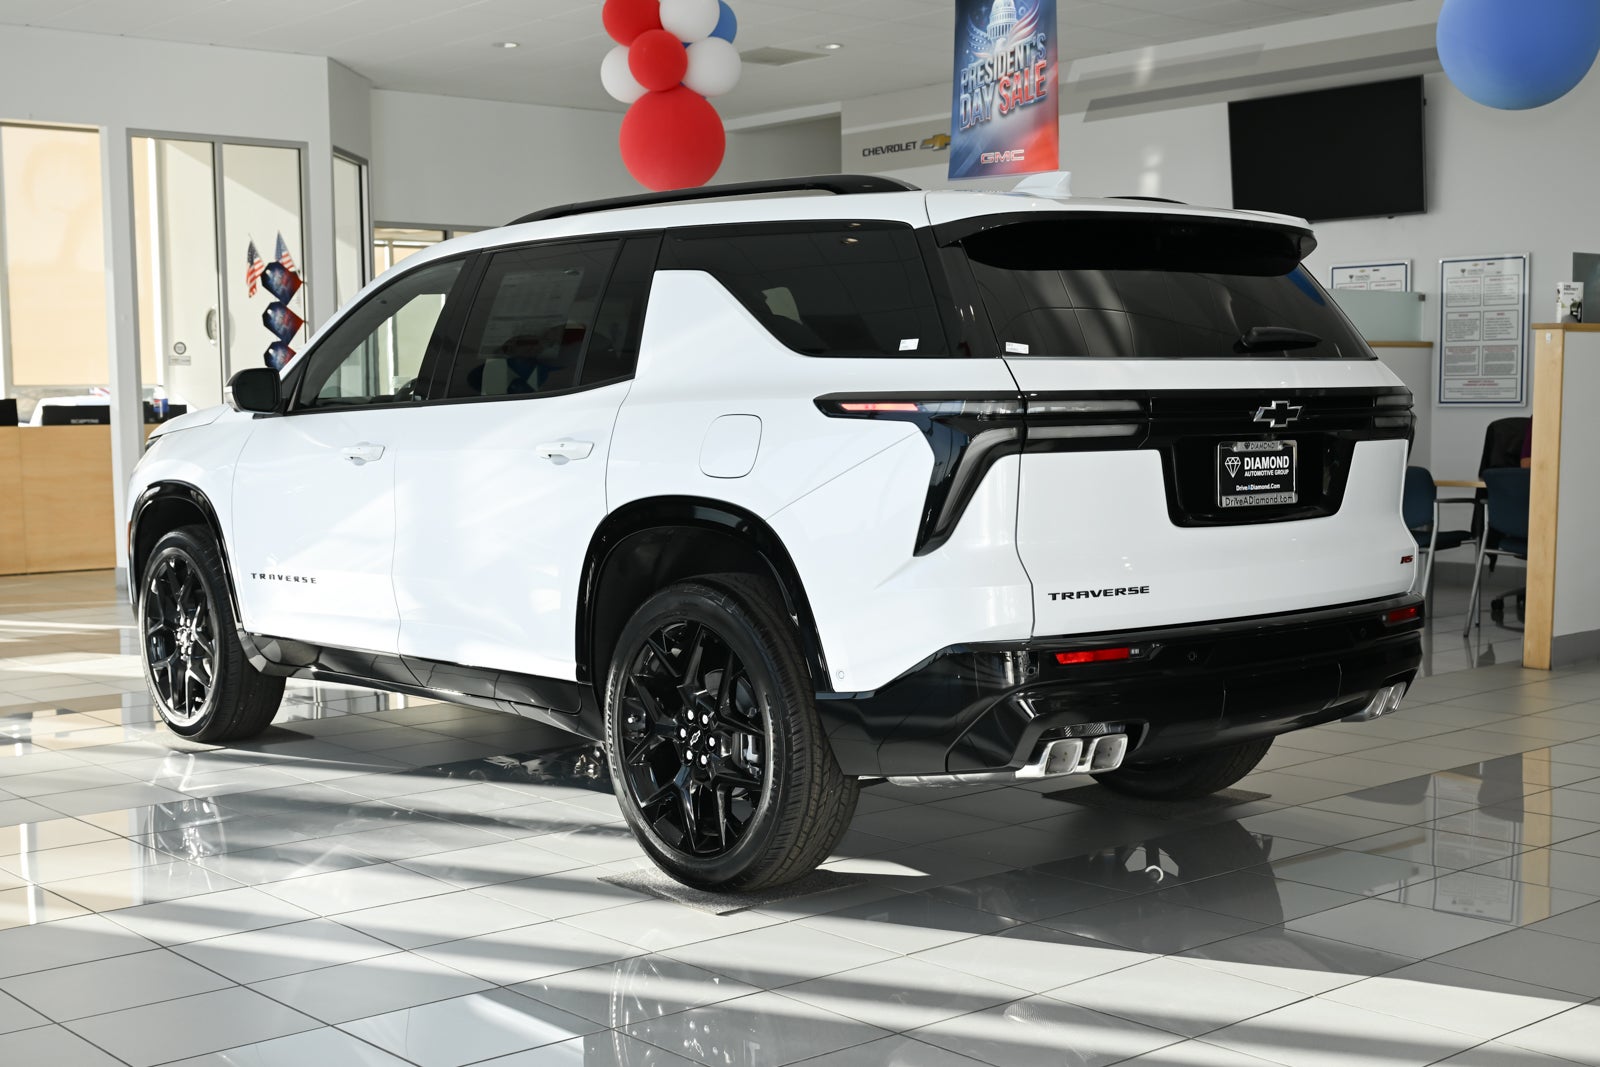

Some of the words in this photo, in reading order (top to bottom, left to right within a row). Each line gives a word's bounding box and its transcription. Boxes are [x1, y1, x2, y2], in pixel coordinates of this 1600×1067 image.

[960, 32, 1047, 94] PRESIDENT'S
[960, 82, 995, 131] DAY
[999, 60, 1047, 114] SALE
[862, 141, 917, 157] CHEVROLET
[980, 149, 1025, 164] GMC
[1250, 442, 1275, 450] DIAMOND
[1244, 456, 1290, 470] DIAMOND
[251, 572, 317, 584] TRAVERSE
[1047, 585, 1150, 601] TRAVERSE
